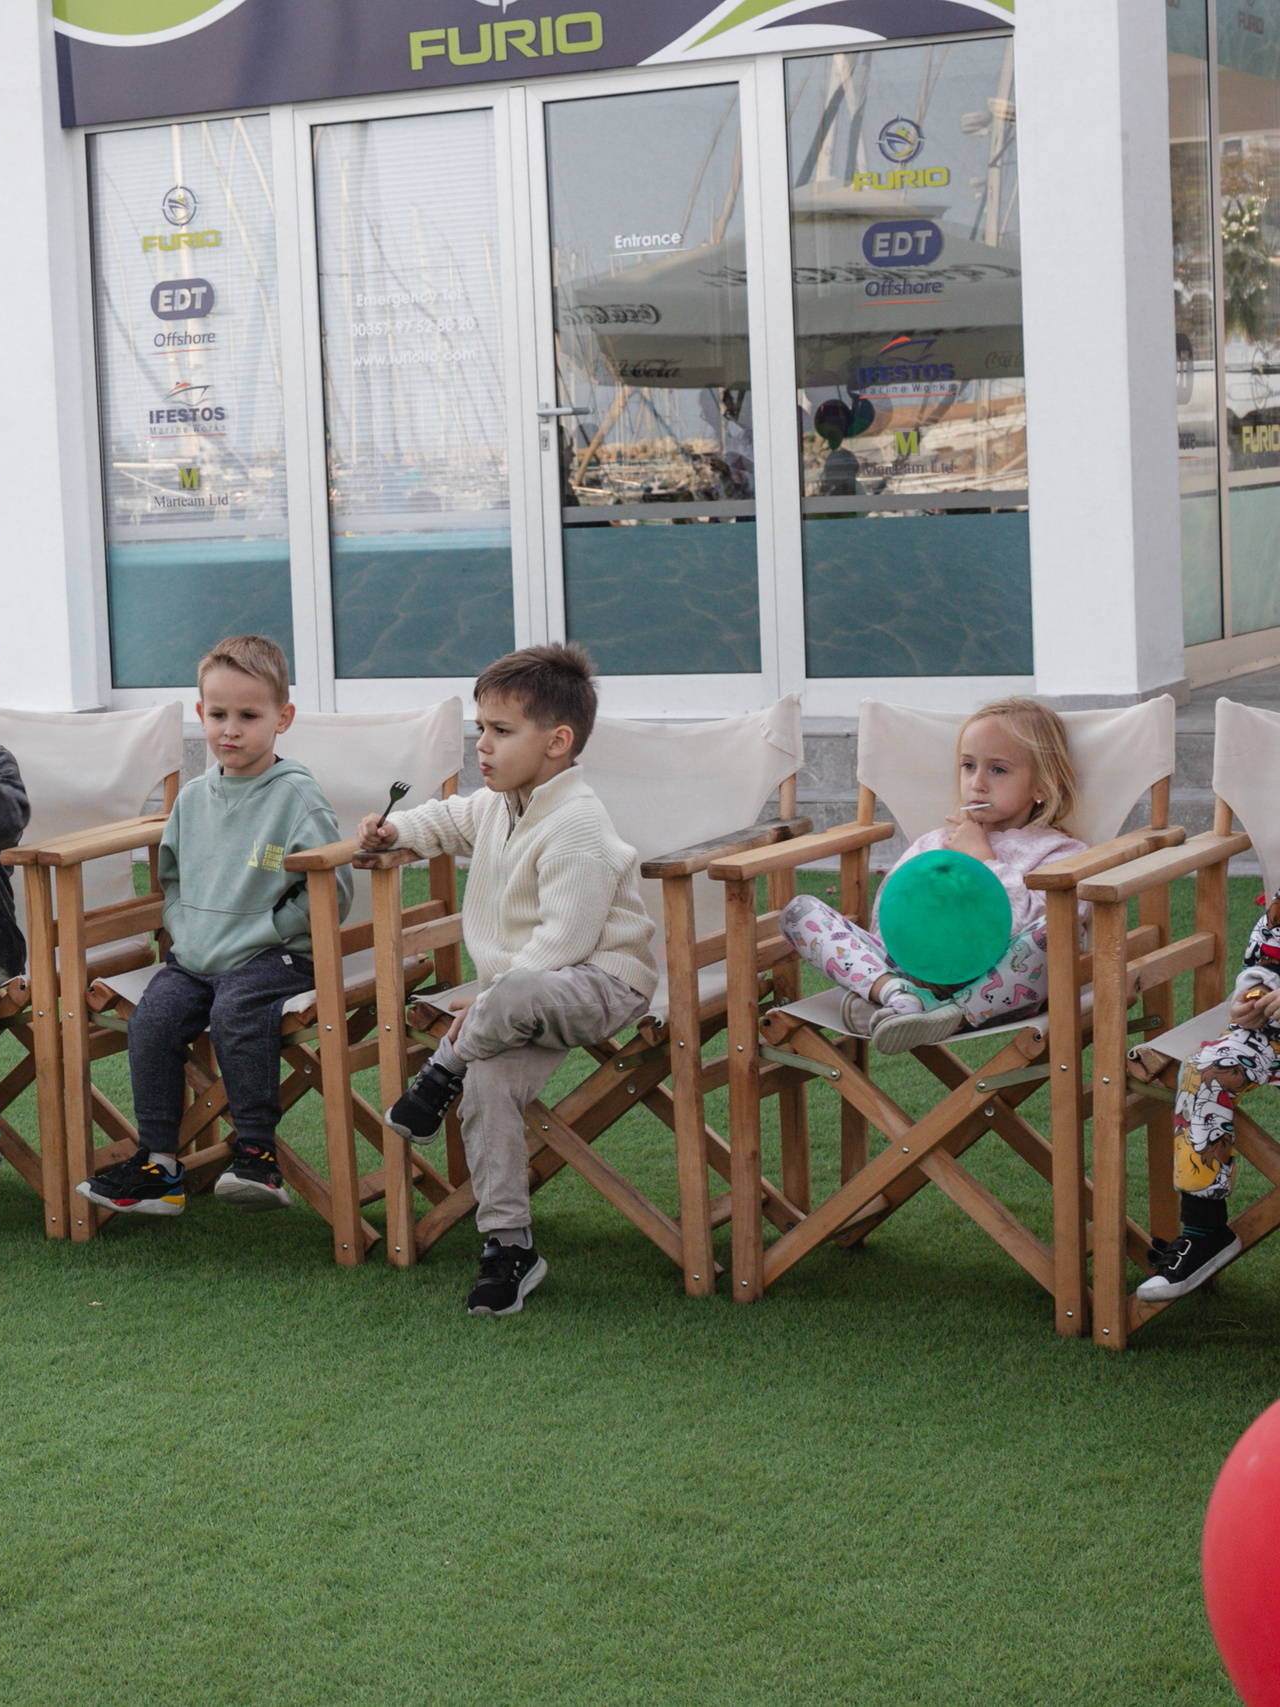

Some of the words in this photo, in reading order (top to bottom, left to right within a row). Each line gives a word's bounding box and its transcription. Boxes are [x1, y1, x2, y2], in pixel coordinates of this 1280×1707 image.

[409, 11, 604, 71] FURIO
[852, 167, 949, 191] FURIO
[142, 229, 221, 253] FURIO
[614, 232, 682, 249] Entrance
[872, 229, 933, 257] EDT
[864, 278, 943, 298] Offshore
[157, 286, 208, 313] EDT
[356, 290, 437, 308] Emergency
[153, 331, 216, 348] Offshore
[858, 363, 954, 384] IFESTOS
[912, 381, 956, 393] Works
[149, 406, 226, 424] IFESTOS
[930, 459, 957, 475] Ltd
[153, 494, 206, 510] Marteam
[208, 492, 230, 507] Ltd
